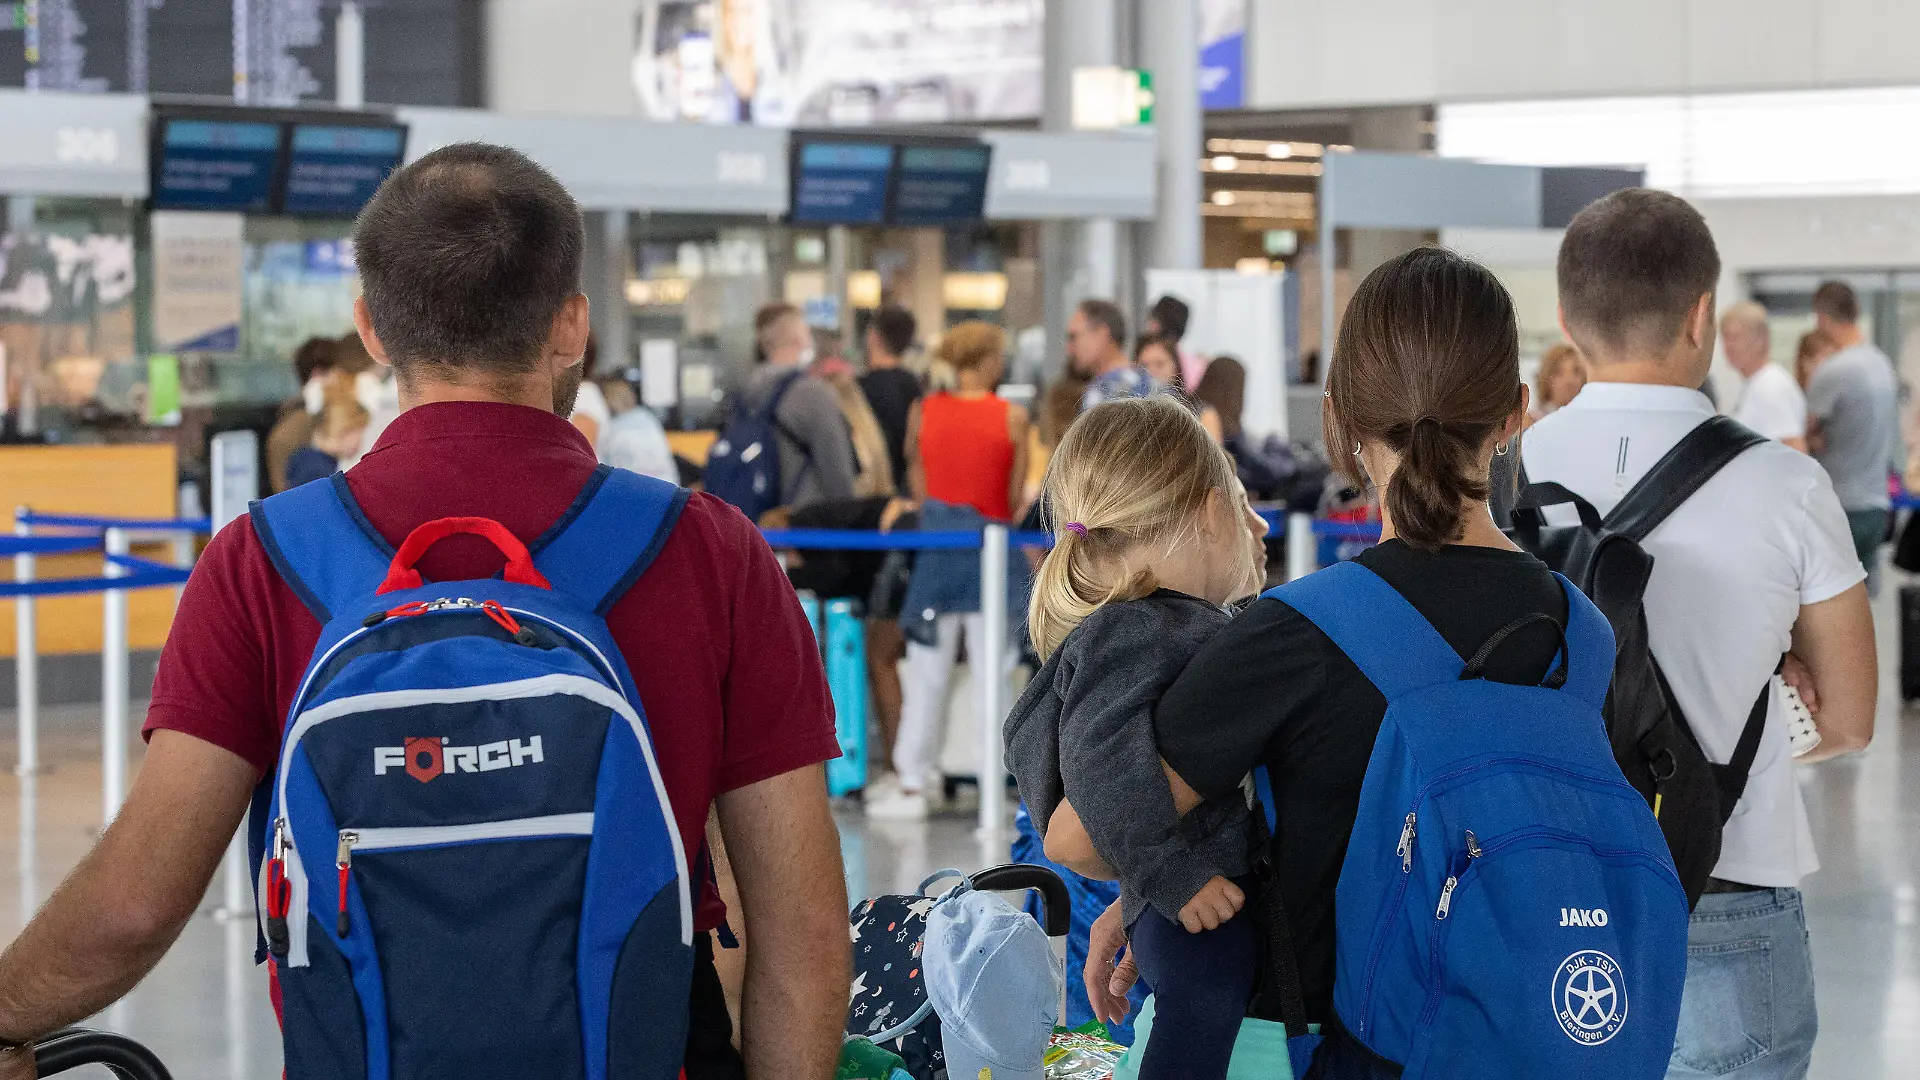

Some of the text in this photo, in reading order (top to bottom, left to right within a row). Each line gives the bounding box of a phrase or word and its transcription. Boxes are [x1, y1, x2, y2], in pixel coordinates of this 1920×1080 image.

[1559, 907, 1608, 927] JAKO
[1565, 956, 1587, 975] DJK
[1595, 956, 1616, 975] TSV
[1559, 1009, 1622, 1042] Bieringen e.V.
